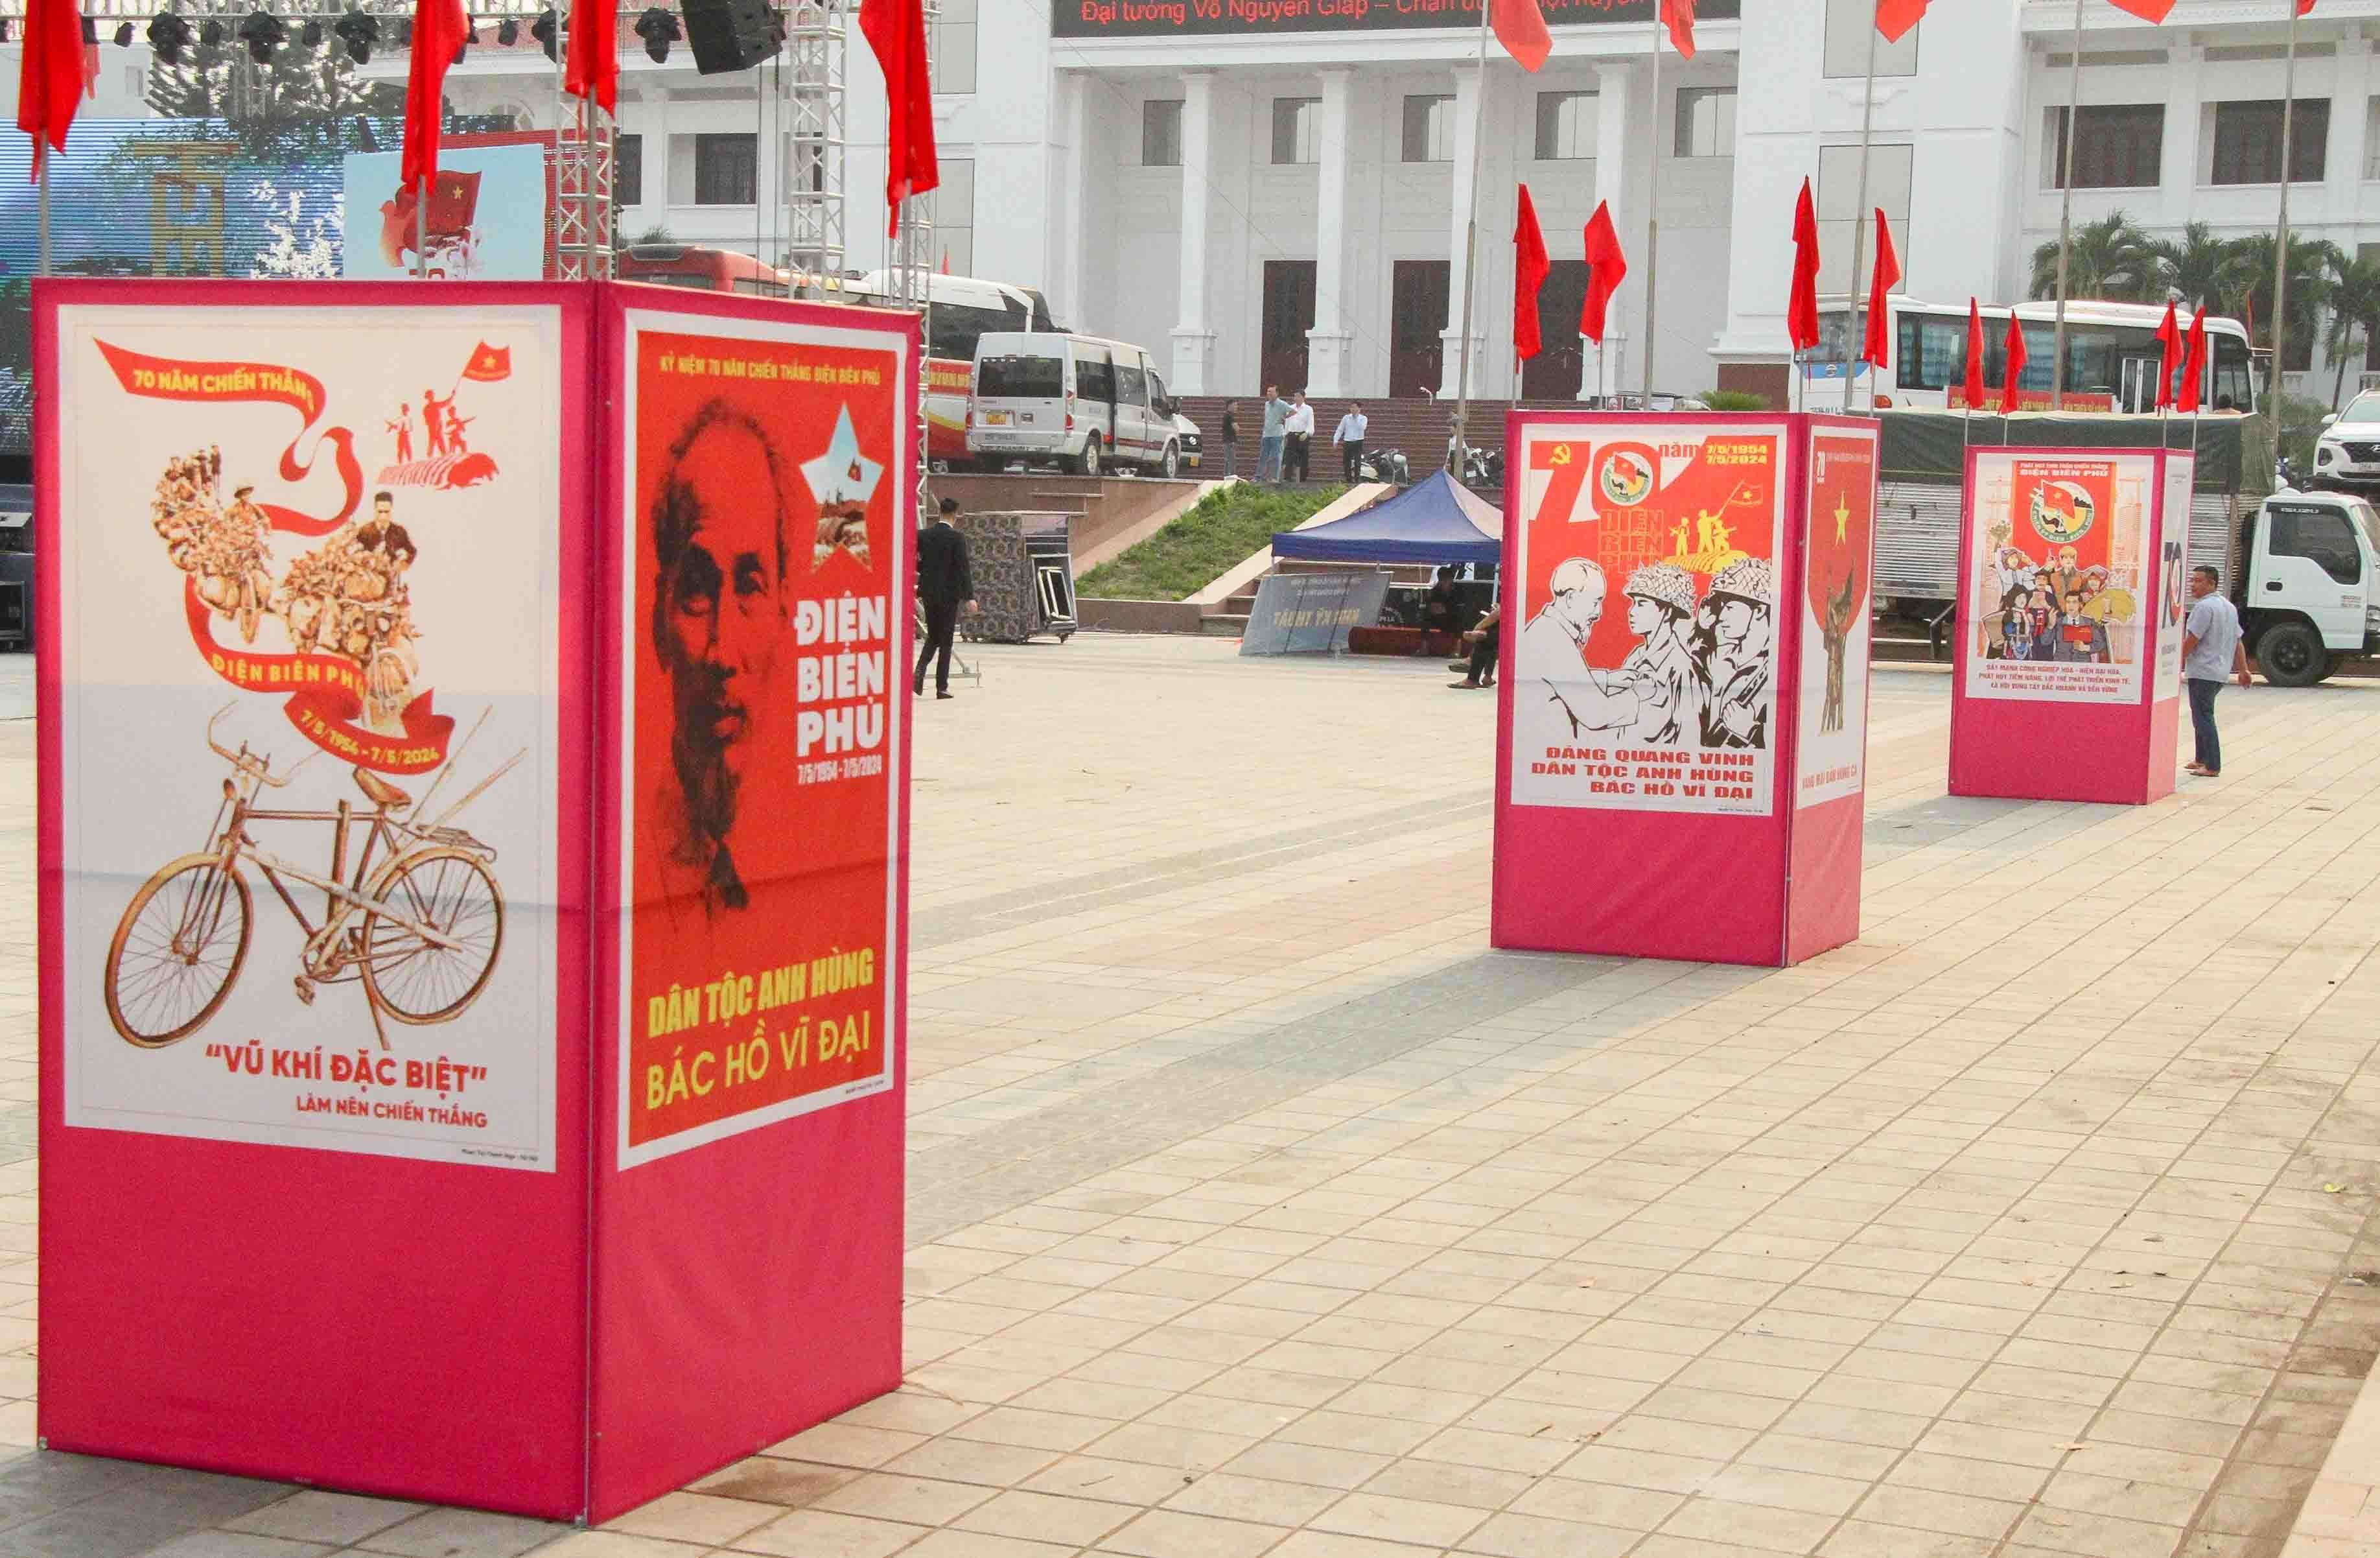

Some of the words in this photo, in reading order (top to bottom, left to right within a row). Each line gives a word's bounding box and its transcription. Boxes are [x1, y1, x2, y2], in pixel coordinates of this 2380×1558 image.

[1081, 1, 1117, 25] Đại
[133, 370, 156, 388] 70
[158, 370, 198, 392] NĂM
[202, 367, 255, 393] CHIẾN
[793, 589, 885, 647] ĐIỆN
[212, 654, 262, 684] ĐIỆN
[269, 659, 320, 683] BIÊN
[797, 648, 884, 703] BIÊN
[797, 696, 883, 757] PHỦ
[371, 746, 439, 765] 7/5/2024
[1531, 761, 1576, 775] DÂN
[1584, 764, 1629, 781] TỘC
[1635, 767, 1682, 781] ANH
[1615, 749, 1691, 764] QUANG
[1699, 752, 1754, 766] VINH
[1590, 779, 1635, 794] BÁC
[1714, 786, 1753, 802] ĐẠI
[649, 984, 701, 1039] DÂN
[706, 971, 753, 1027] TỘC
[758, 963, 807, 1011] ANH
[811, 947, 874, 998] HÙNG
[205, 1039, 264, 1074] “VŨ
[272, 1046, 322, 1080] KHÍ
[330, 1049, 397, 1093] ĐẶC
[406, 1056, 488, 1100] BIỆT”
[648, 1045, 716, 1111] BÁC
[725, 1018, 770, 1088] HỒ
[780, 1016, 811, 1071] VĨ
[819, 1010, 871, 1063] ĐẠI
[297, 1092, 331, 1112] LÀM
[336, 1095, 369, 1116] NÊN
[373, 1098, 425, 1122] CHIẾN
[428, 1104, 488, 1128] THẮNG
